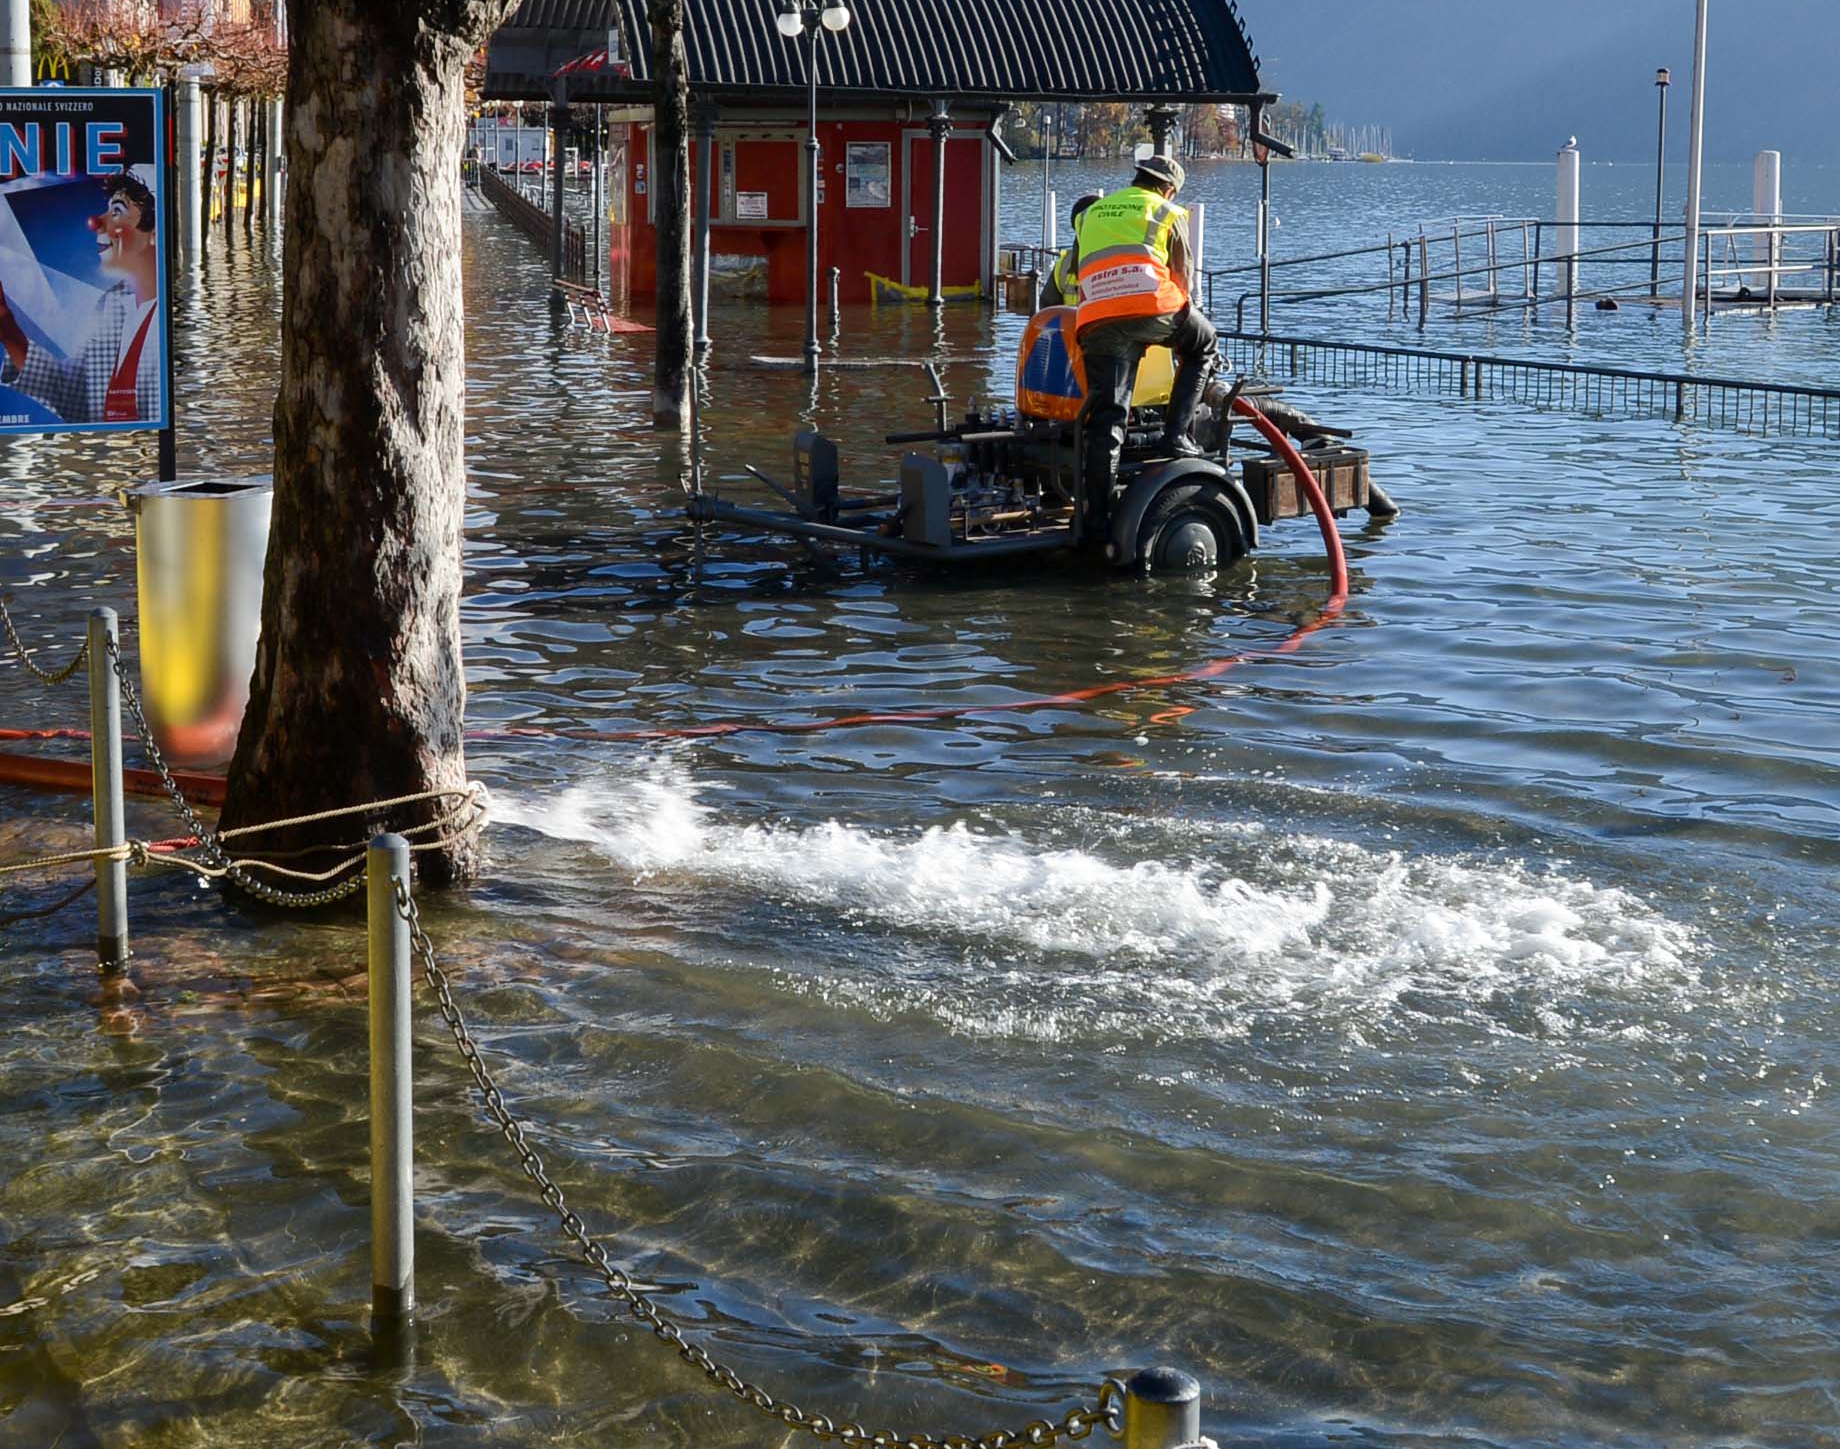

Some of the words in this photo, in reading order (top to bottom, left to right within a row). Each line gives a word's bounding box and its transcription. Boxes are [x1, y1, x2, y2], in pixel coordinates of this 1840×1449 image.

[6, 102, 52, 111] NAZIONALE
[55, 102, 94, 112] SVIZZERO
[1091, 269, 1118, 282] astra
[1122, 265, 1143, 274] s.a.
